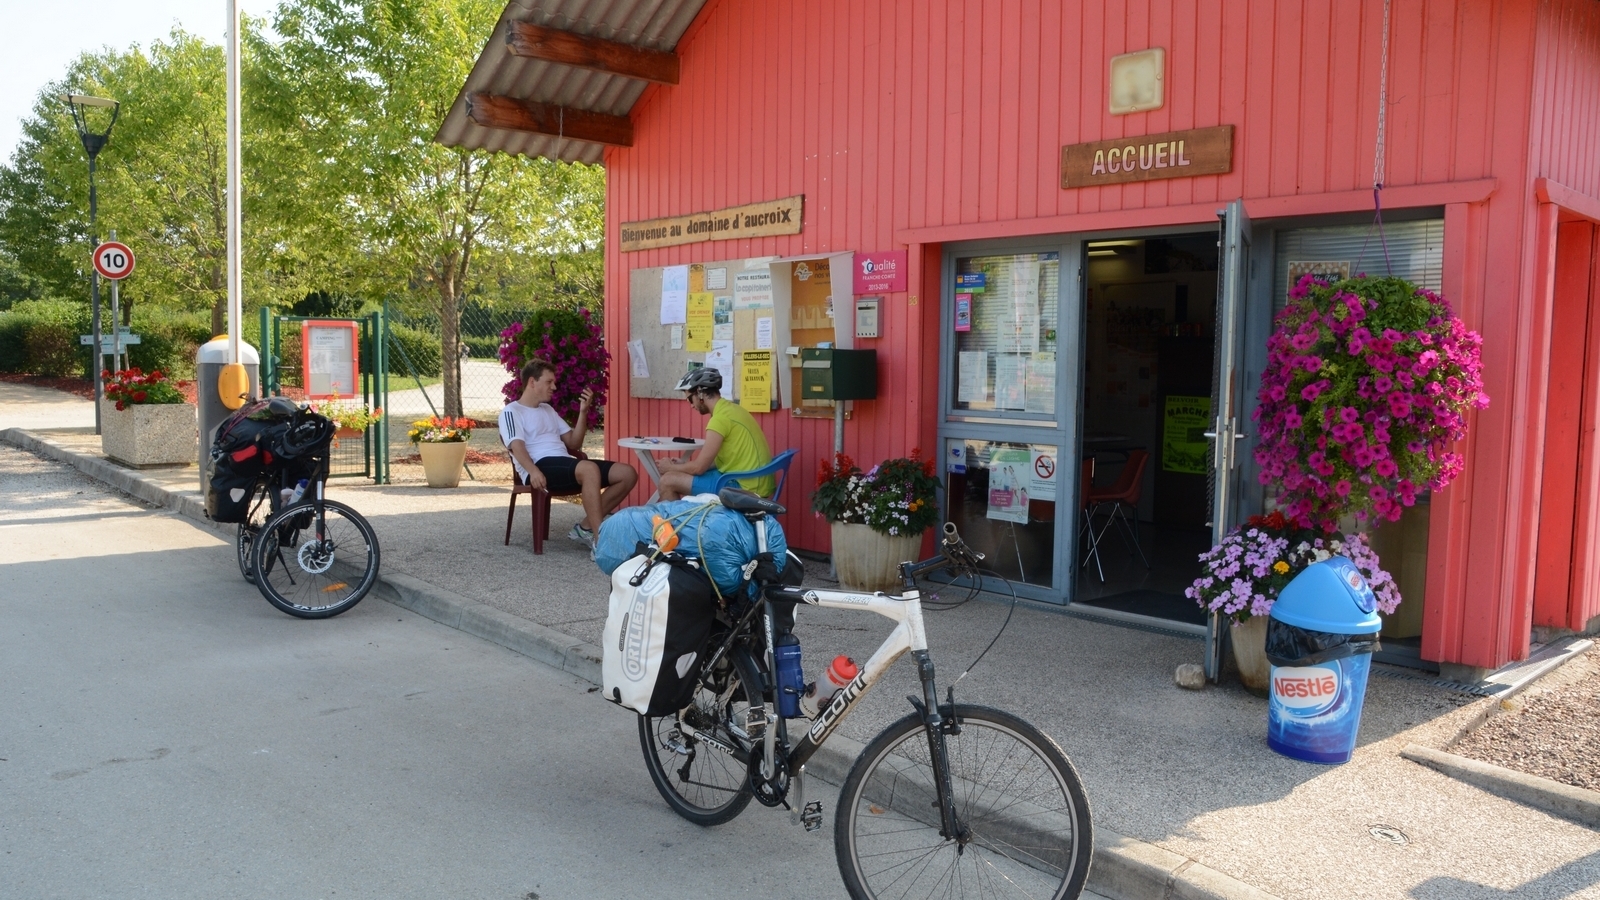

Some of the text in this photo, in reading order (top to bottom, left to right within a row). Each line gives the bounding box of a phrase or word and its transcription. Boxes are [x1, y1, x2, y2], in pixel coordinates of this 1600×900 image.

[1091, 140, 1190, 176] ACCUEIL
[622, 207, 792, 243] Bienvenue au domaine d'aucroix
[103, 253, 125, 268] 10
[866, 259, 896, 273] Qualité
[757, 499, 774, 508] SCOTT
[627, 601, 645, 672] ORTLIEB
[1275, 676, 1335, 698] Nestlé
[809, 670, 868, 742] SCOTT
[694, 732, 732, 754] SCOTT
